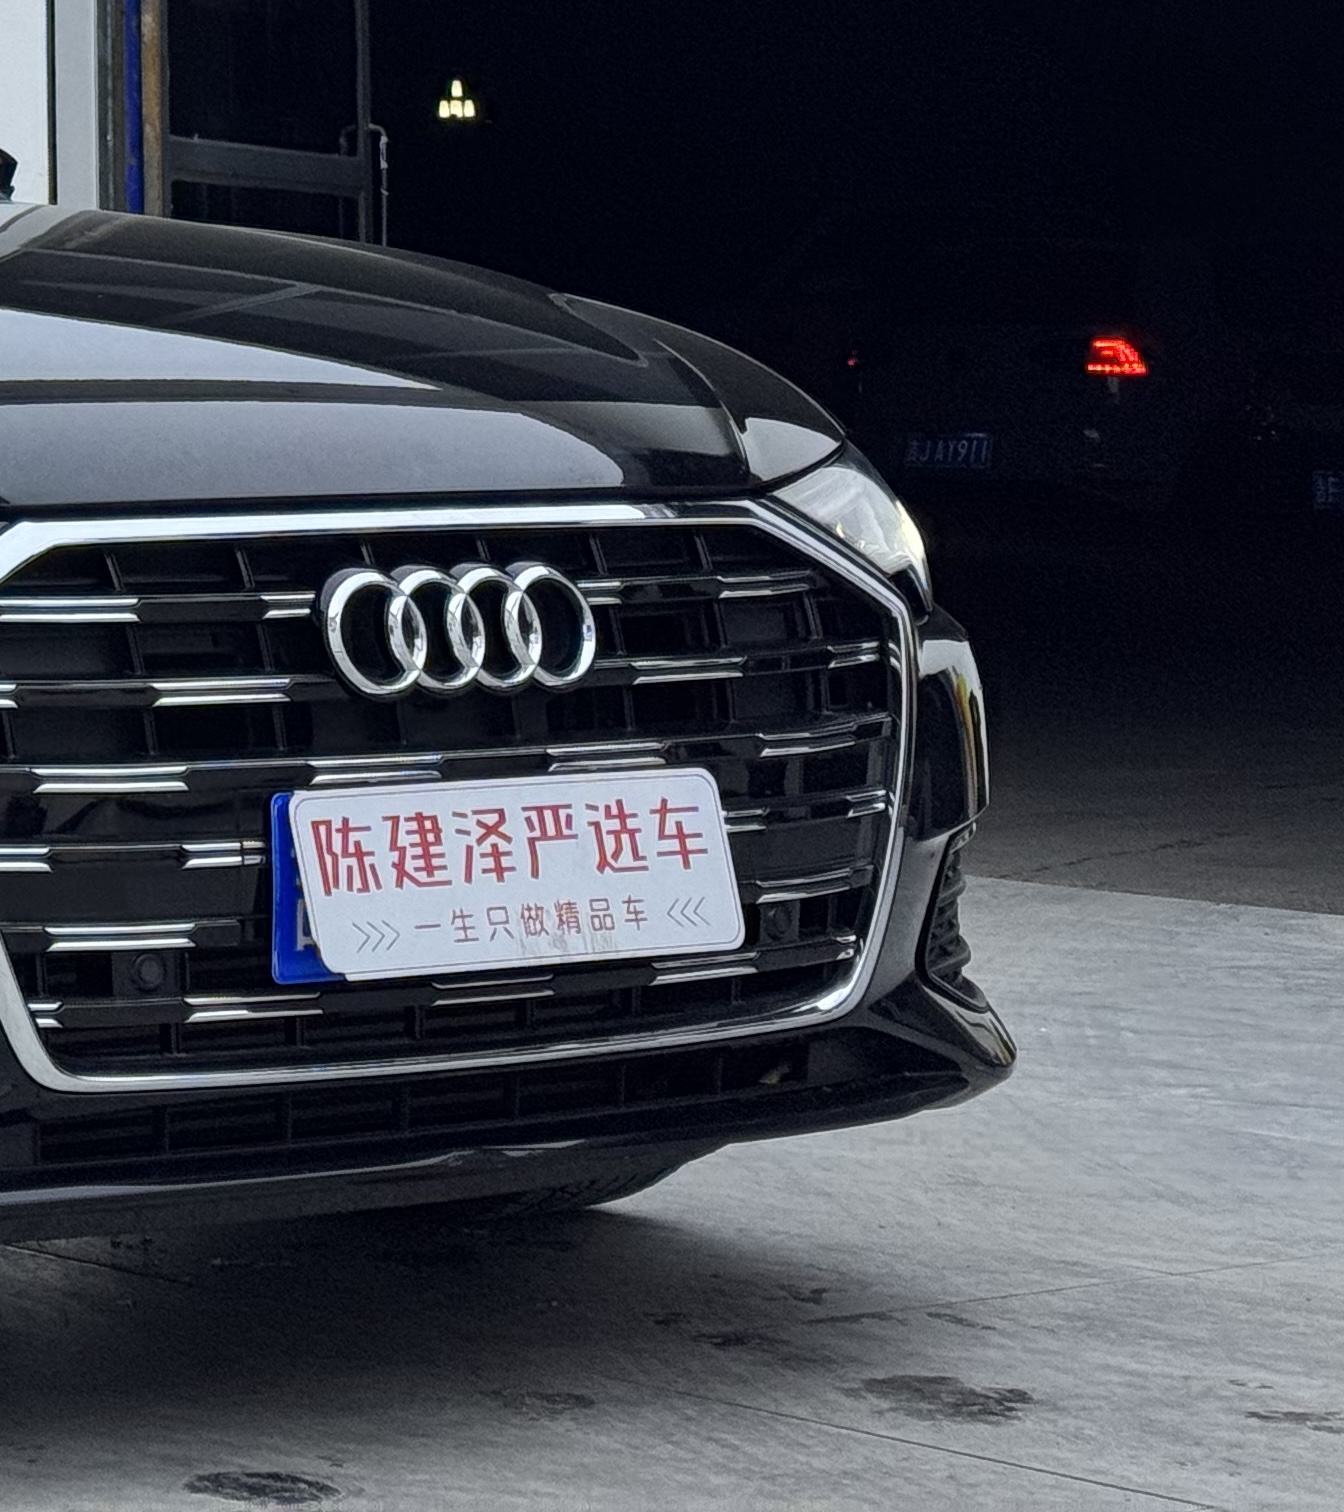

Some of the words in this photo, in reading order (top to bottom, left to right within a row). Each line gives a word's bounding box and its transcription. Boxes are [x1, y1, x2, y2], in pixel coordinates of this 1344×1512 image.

[310, 798, 709, 896] 陈建泽严选车
[414, 896, 650, 944] 一生只做精品车
